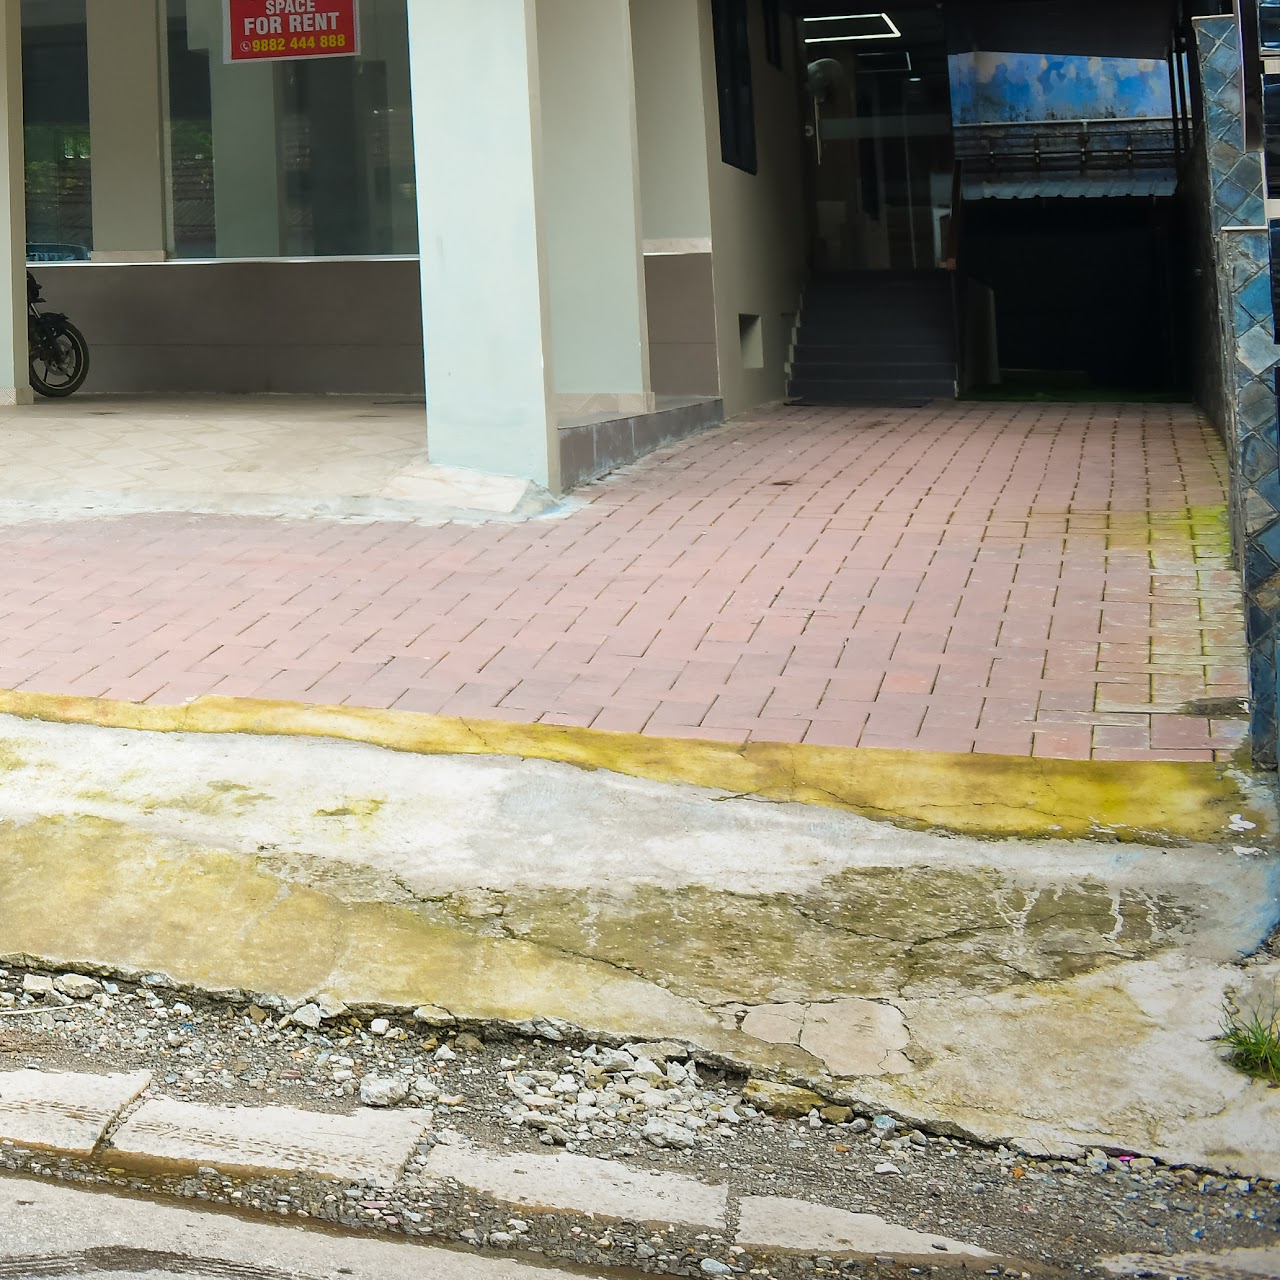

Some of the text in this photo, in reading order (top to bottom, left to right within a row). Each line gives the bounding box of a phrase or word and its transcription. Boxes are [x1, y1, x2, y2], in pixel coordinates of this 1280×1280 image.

[244, 12, 339, 36] FOR RENT
[252, 34, 346, 52] 9882 444 888
